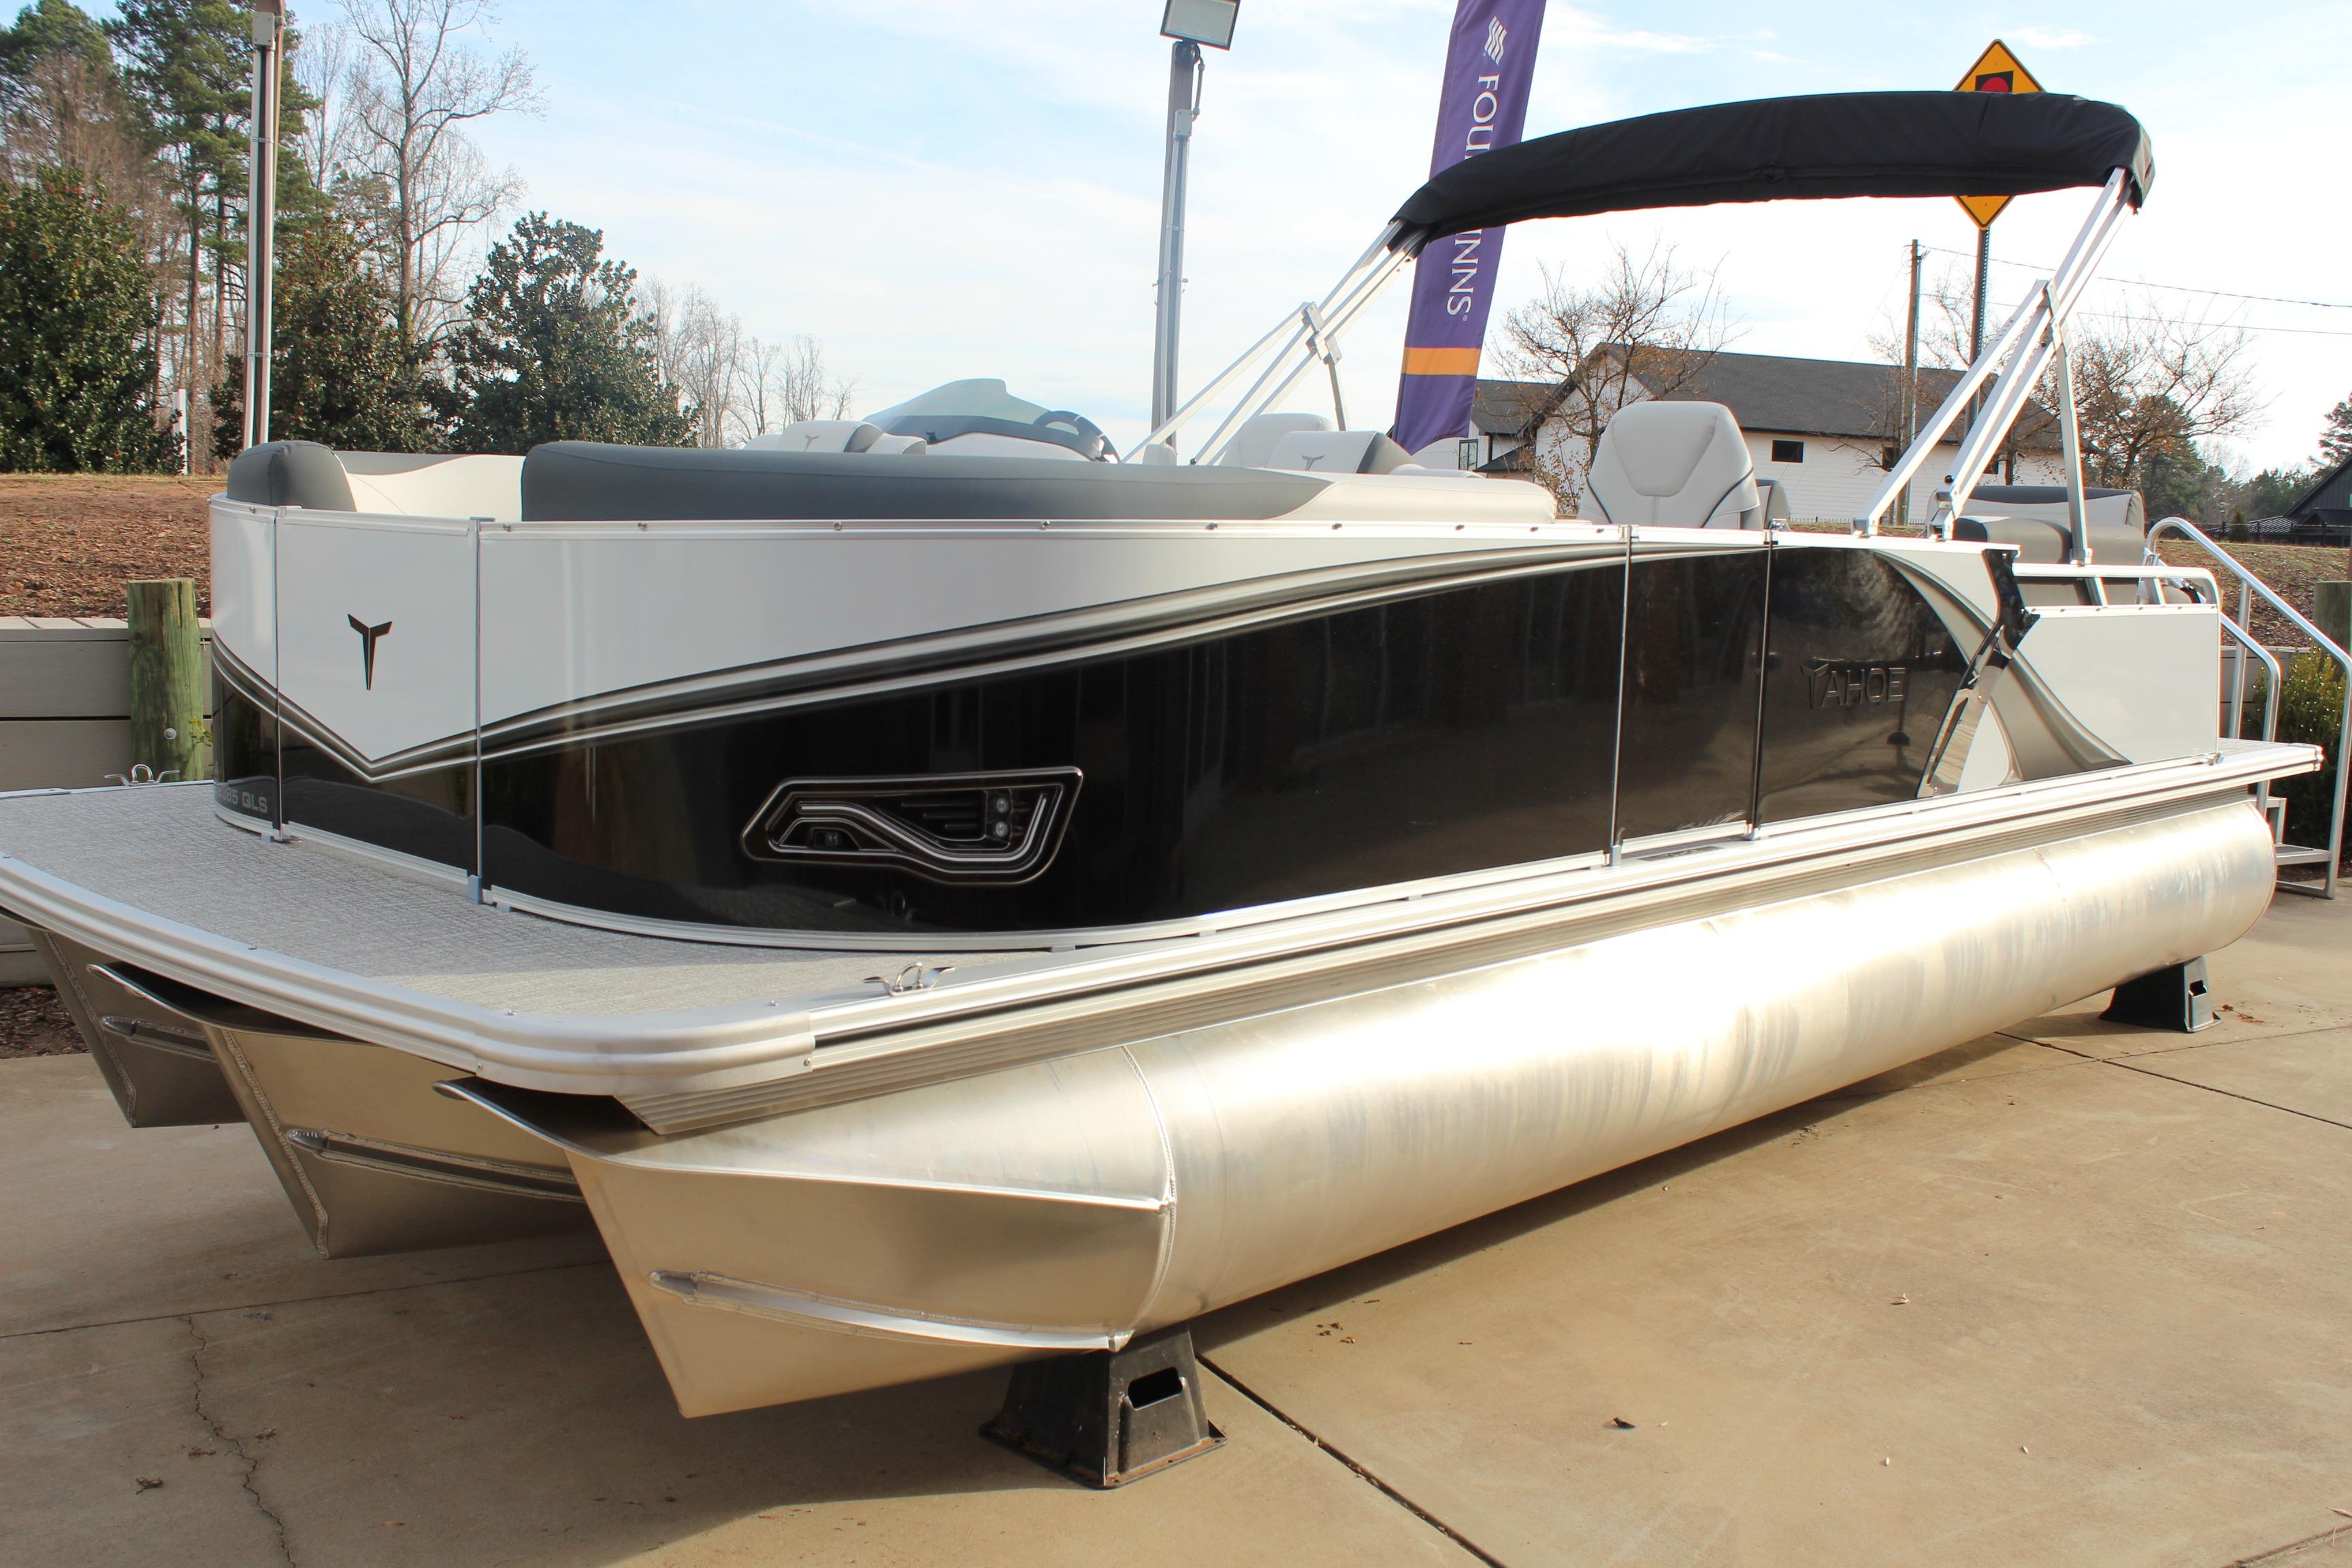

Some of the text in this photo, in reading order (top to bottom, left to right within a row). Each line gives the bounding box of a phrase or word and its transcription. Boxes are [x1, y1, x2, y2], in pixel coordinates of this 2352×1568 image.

[1465, 75, 1500, 160] FOU
[1800, 663, 1906, 710] TAHOE
[242, 791, 267, 813] QLS
